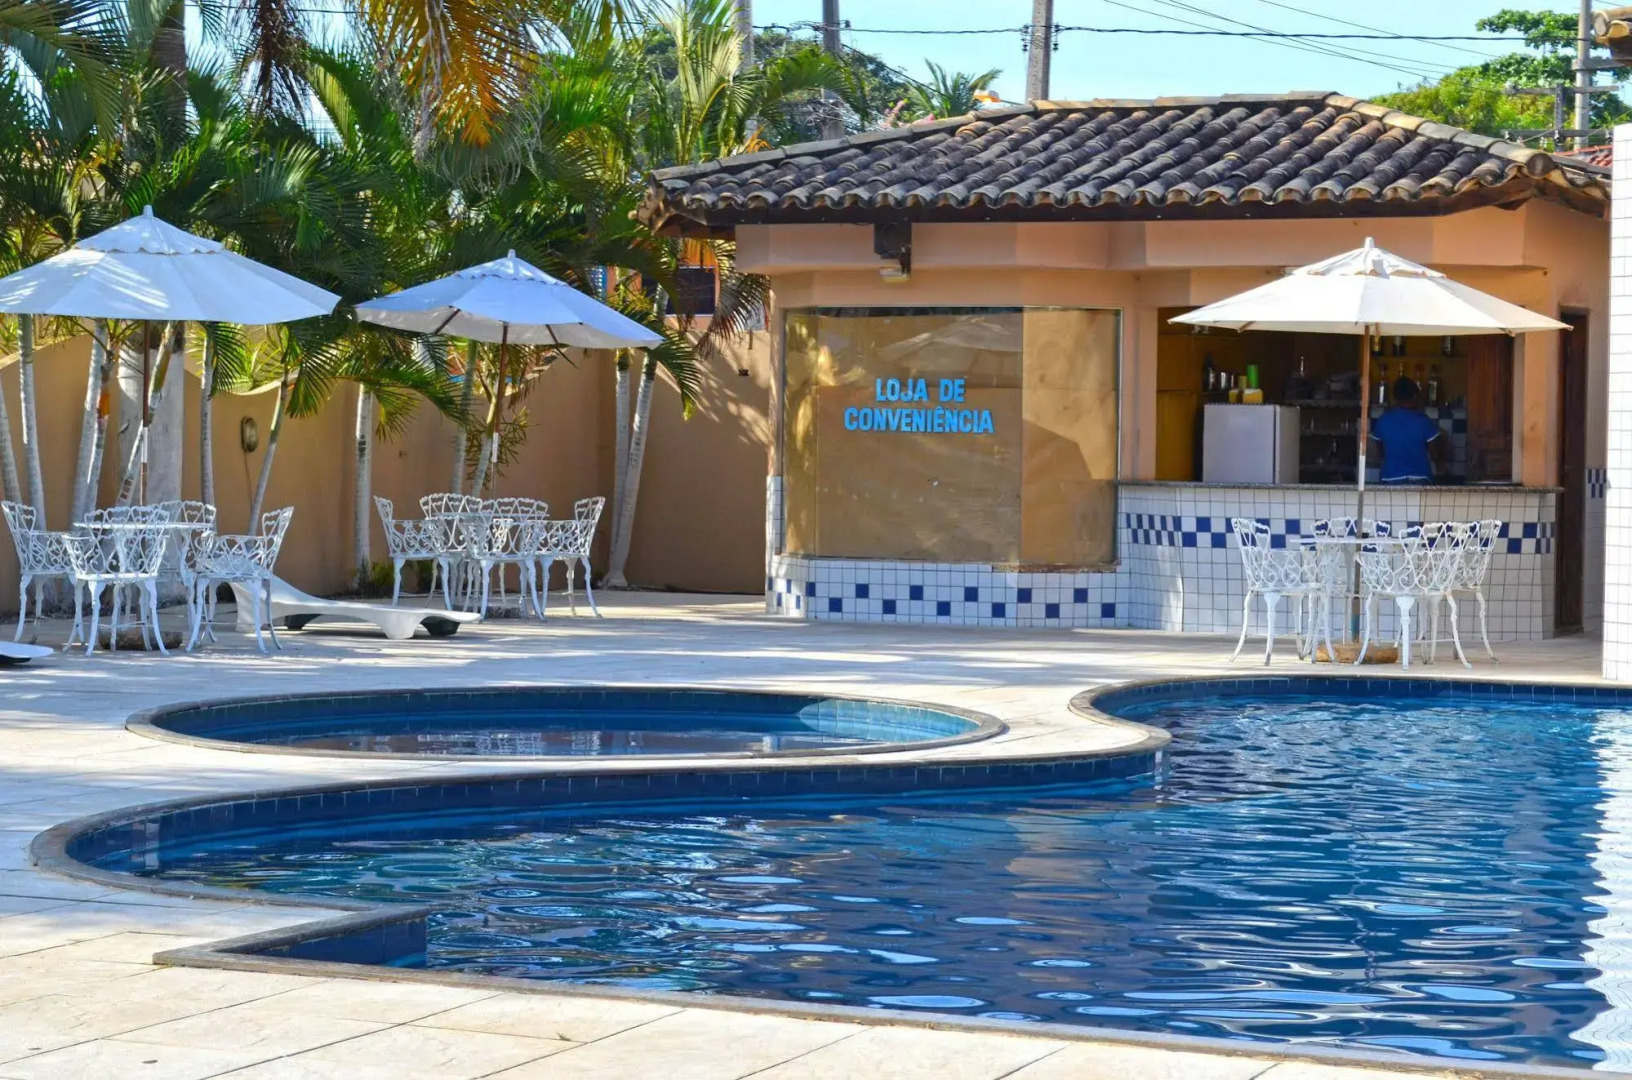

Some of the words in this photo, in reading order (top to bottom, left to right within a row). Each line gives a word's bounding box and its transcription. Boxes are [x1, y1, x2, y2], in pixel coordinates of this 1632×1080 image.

[875, 378, 929, 402] LOJA
[940, 378, 965, 402] DE
[844, 406, 994, 433] CONVENIÊNCIA
